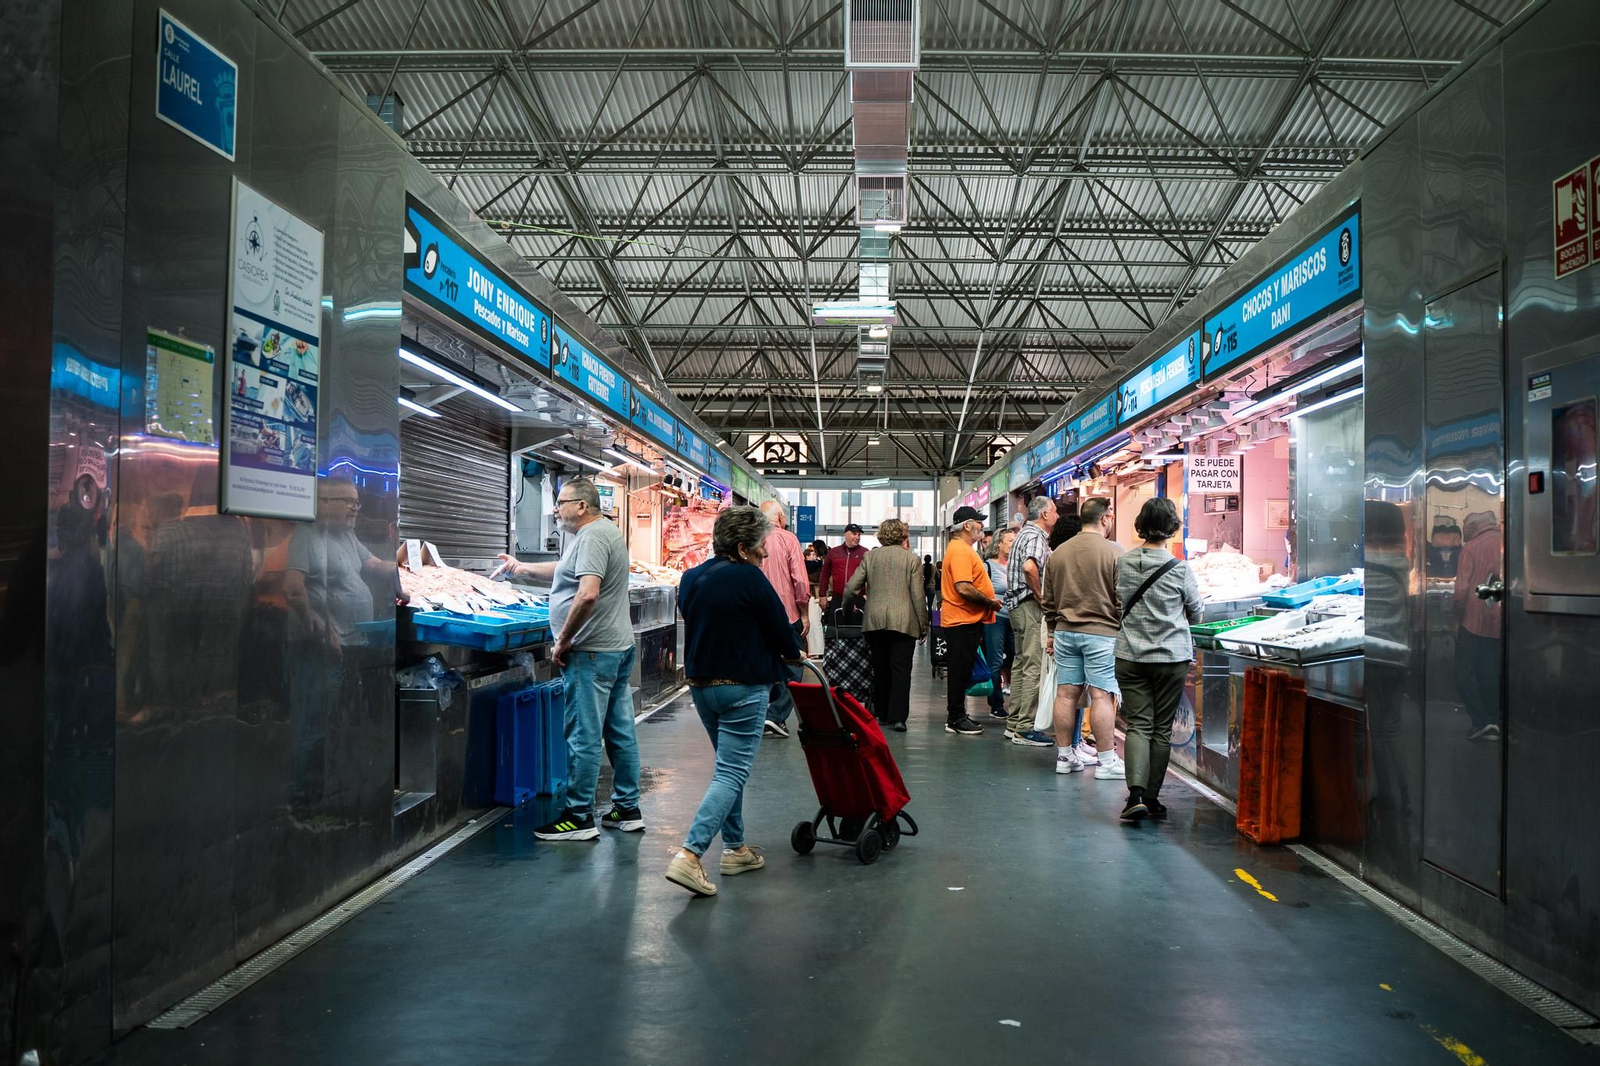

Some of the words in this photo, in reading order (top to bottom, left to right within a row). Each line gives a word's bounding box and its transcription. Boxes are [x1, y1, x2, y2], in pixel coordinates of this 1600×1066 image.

[164, 47, 180, 64] CALLE
[163, 59, 203, 106] LAUREL
[1560, 245, 1577, 261] BOCA
[1577, 241, 1585, 254] DE
[238, 258, 269, 282] CASIOPEA
[1559, 254, 1586, 272] INCENDIO
[1242, 285, 1272, 323] CHOCOS
[1273, 279, 1280, 302] Y
[1281, 247, 1327, 298] MARISCOS
[467, 266, 494, 303] JONY
[496, 288, 536, 333] ENRIQUE
[474, 298, 501, 330] Pescados
[506, 320, 529, 348] Mariscos
[1271, 301, 1291, 330] DANI
[1190, 469, 1219, 478] PAGAR
[1220, 469, 1239, 478] CON
[1194, 458, 1206, 467] SE
[1207, 458, 1235, 467] PUEDE
[1197, 480, 1232, 489] TARJETA
